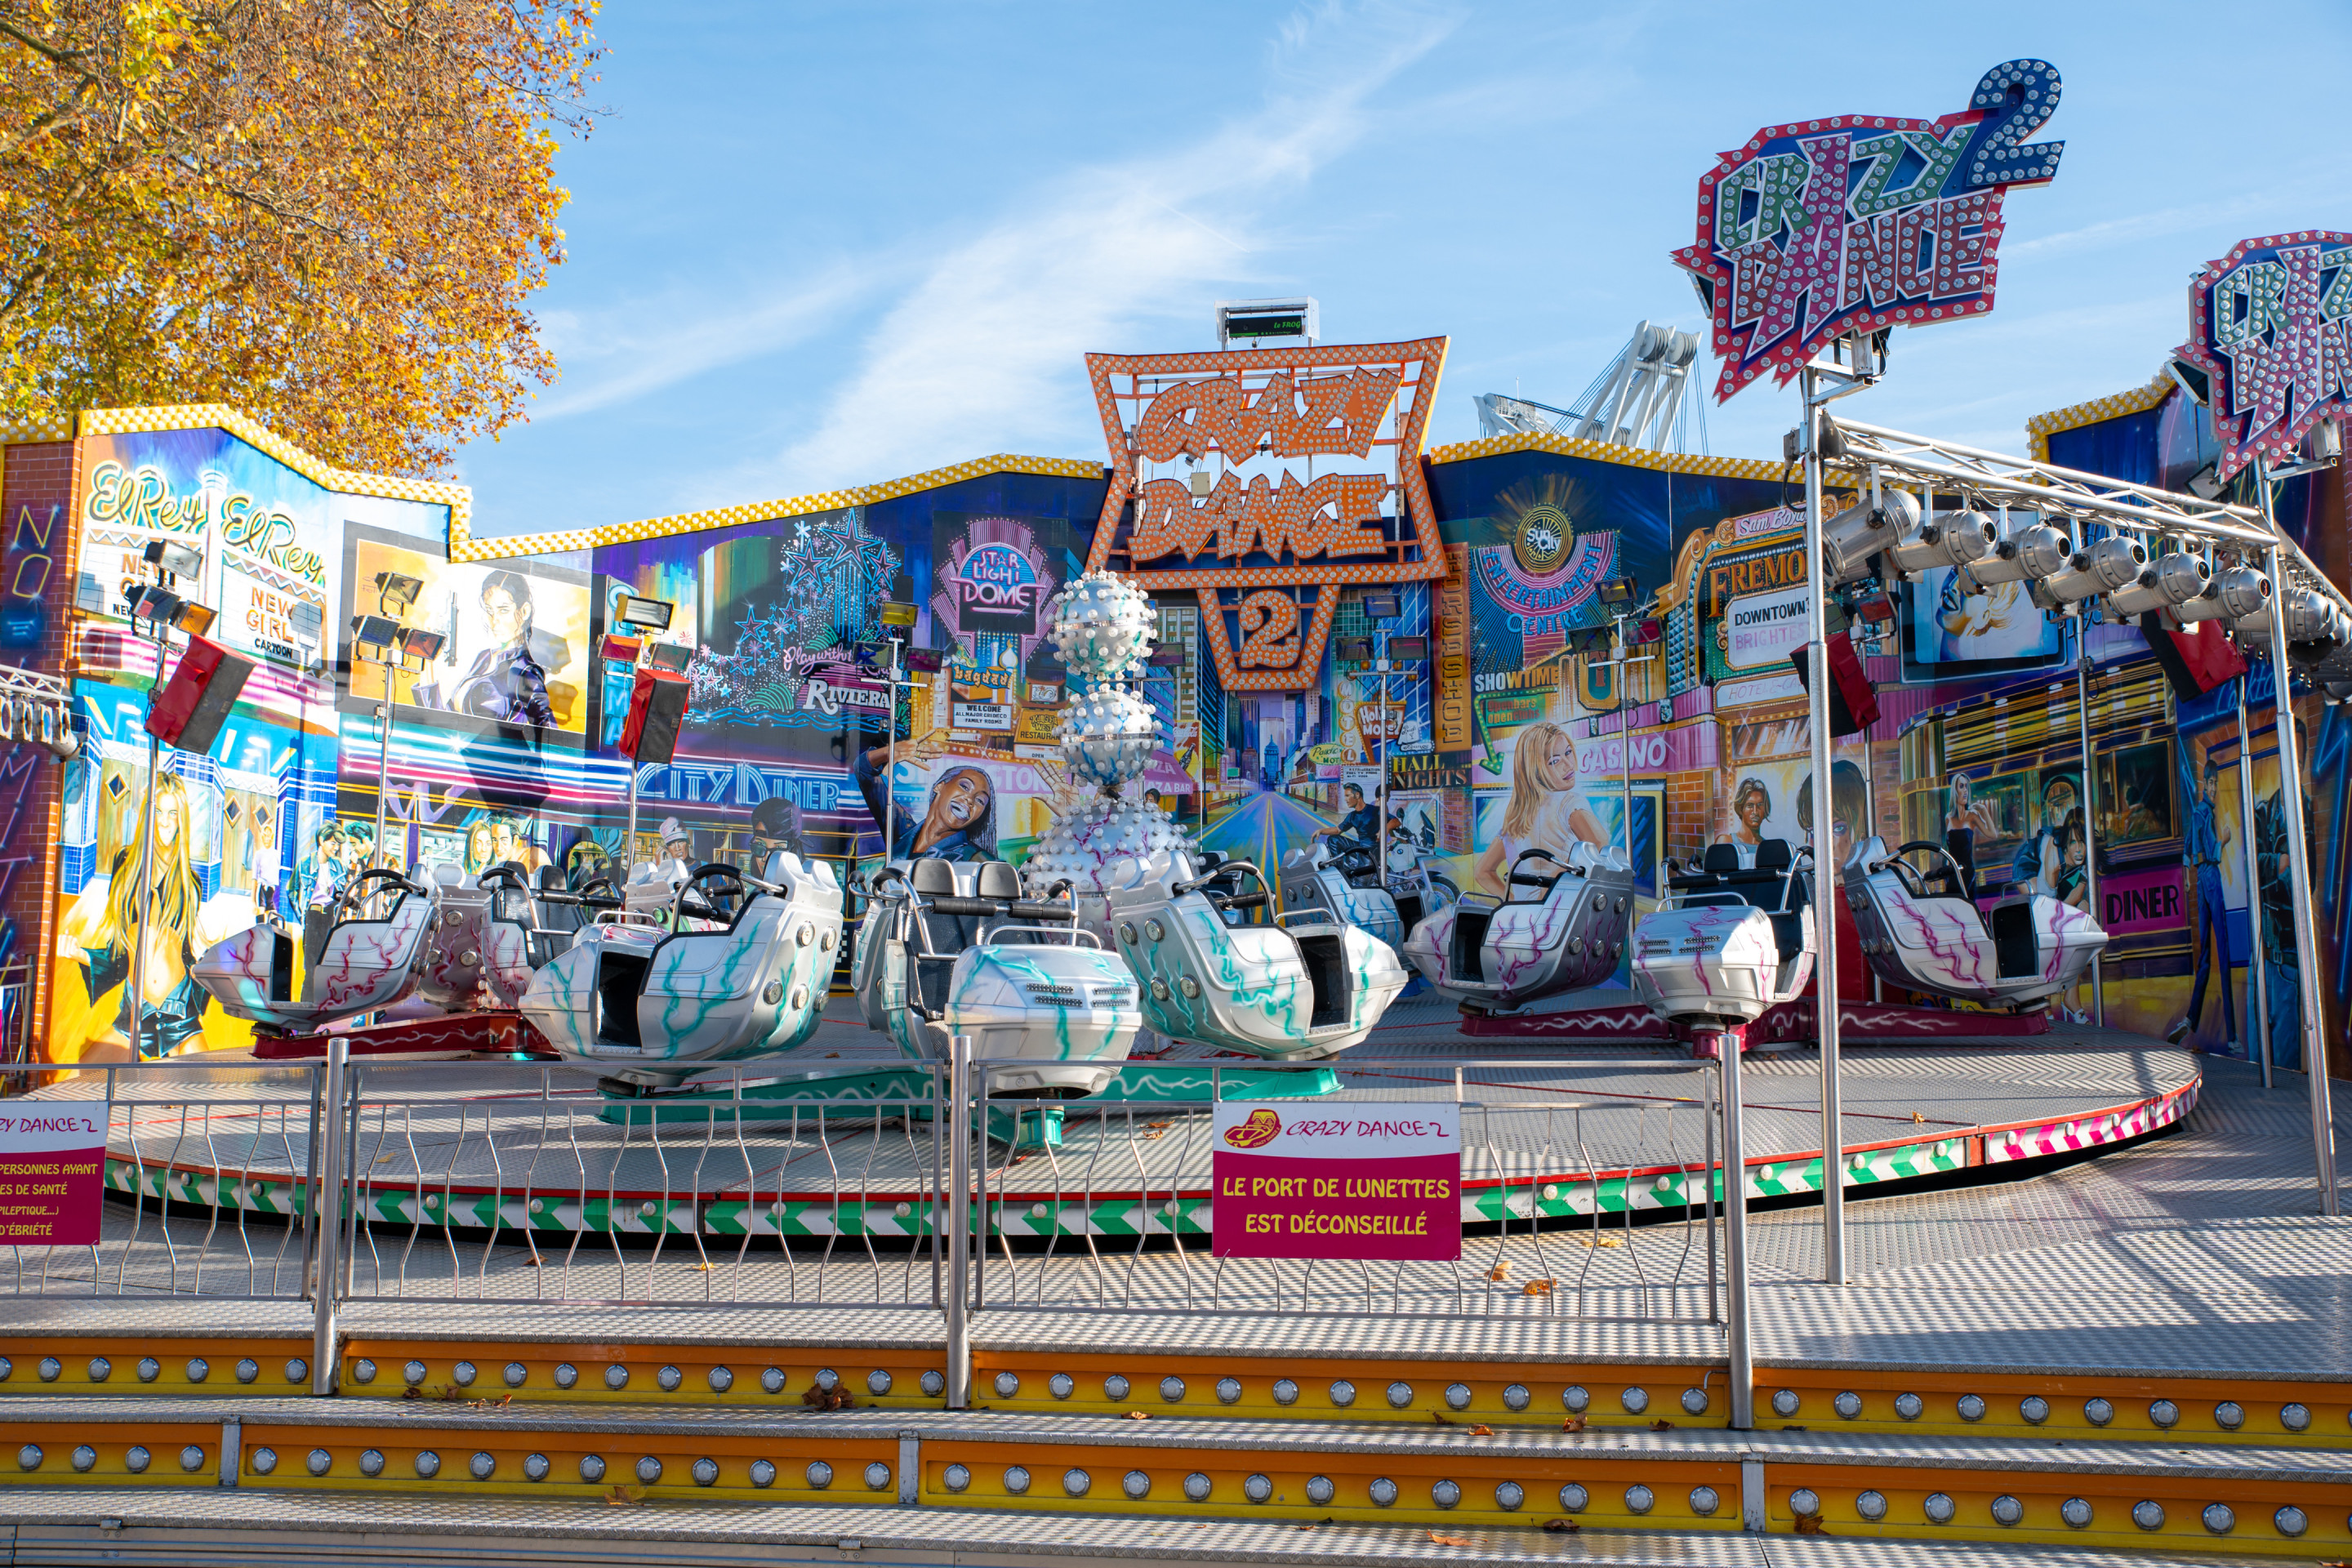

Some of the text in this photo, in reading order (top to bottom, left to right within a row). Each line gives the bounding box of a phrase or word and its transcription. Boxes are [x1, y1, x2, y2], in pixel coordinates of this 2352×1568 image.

[1716, 58, 2065, 251] CRAZY 2
[1713, 188, 1993, 360] DANCE
[1140, 366, 1403, 466] CRAZY
[1126, 469, 1388, 564] DANCE
[1740, 515, 1771, 537] Sam
[1482, 542, 1601, 608] ENTERTAINMENT
[1708, 550, 1808, 617] FREMO
[251, 586, 293, 620] NEW
[957, 578, 1039, 606] DOME
[1507, 606, 1583, 635] CENTRE
[1735, 597, 1809, 626] DOWNTOWN'
[247, 609, 295, 644] GIRL
[1238, 590, 1303, 668] 2
[254, 637, 293, 660] CARTOON
[1474, 666, 1559, 693] SHOWTIME
[803, 679, 890, 715] RIVIERA
[967, 704, 1002, 713] WELCOME
[1020, 732, 1061, 741] RESTAURAN
[1392, 754, 1445, 773] HALL
[1579, 737, 1666, 773] CASNO
[636, 761, 840, 811] CITY DINER
[1174, 783, 1190, 792] BAR
[1392, 768, 1467, 791] NIGHTS
[2106, 884, 2179, 924] DINER
[20, 1117, 80, 1133] DANCE
[82, 1119, 98, 1133] 2
[1286, 1120, 1449, 1138] CRAZY DANCE 2
[63, 1164, 98, 1175] AYANT
[16, 1184, 29, 1195] DE
[33, 1182, 68, 1195] SANTÉ
[1223, 1177, 1450, 1199] LE PORT DE LUNETTES
[1245, 1209, 1428, 1236] EST DÉCONSEILLÉ
